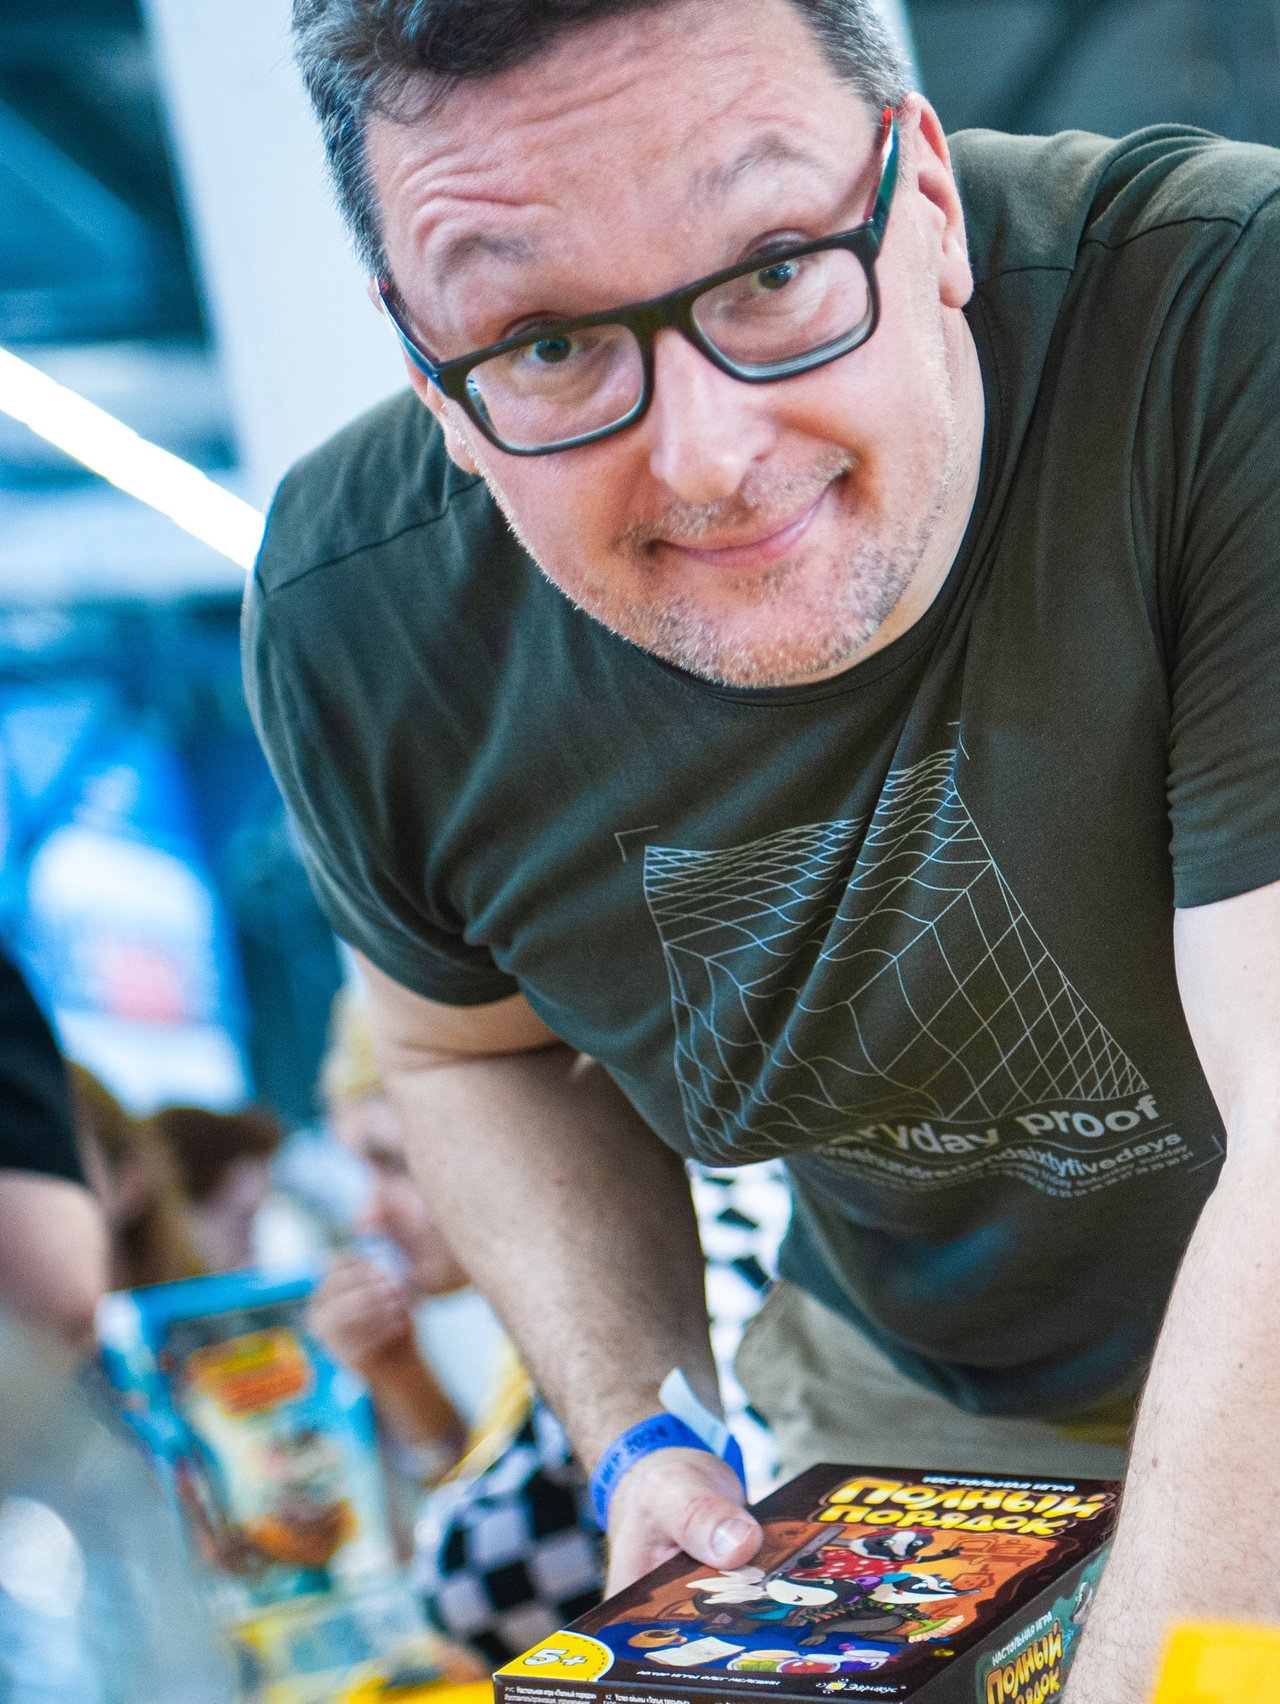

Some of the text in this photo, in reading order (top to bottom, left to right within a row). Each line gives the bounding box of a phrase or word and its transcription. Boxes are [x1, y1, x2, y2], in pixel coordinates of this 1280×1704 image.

[1015, 1094, 1160, 1138] proof
[829, 1479, 1106, 1519] ПОЛНЫЙ
[922, 1474, 1076, 1492] НАСТОЛЬНАЯ ИГРА
[818, 1505, 1068, 1535] ПОРЯДОК
[523, 1648, 589, 1666] 5+
[992, 1611, 1053, 1666] НАСТОЛЬНАЯ ИГРА
[987, 1621, 1062, 1704] ПОЛНЫЙ
[1015, 1666, 1060, 1704] ЯДОК
